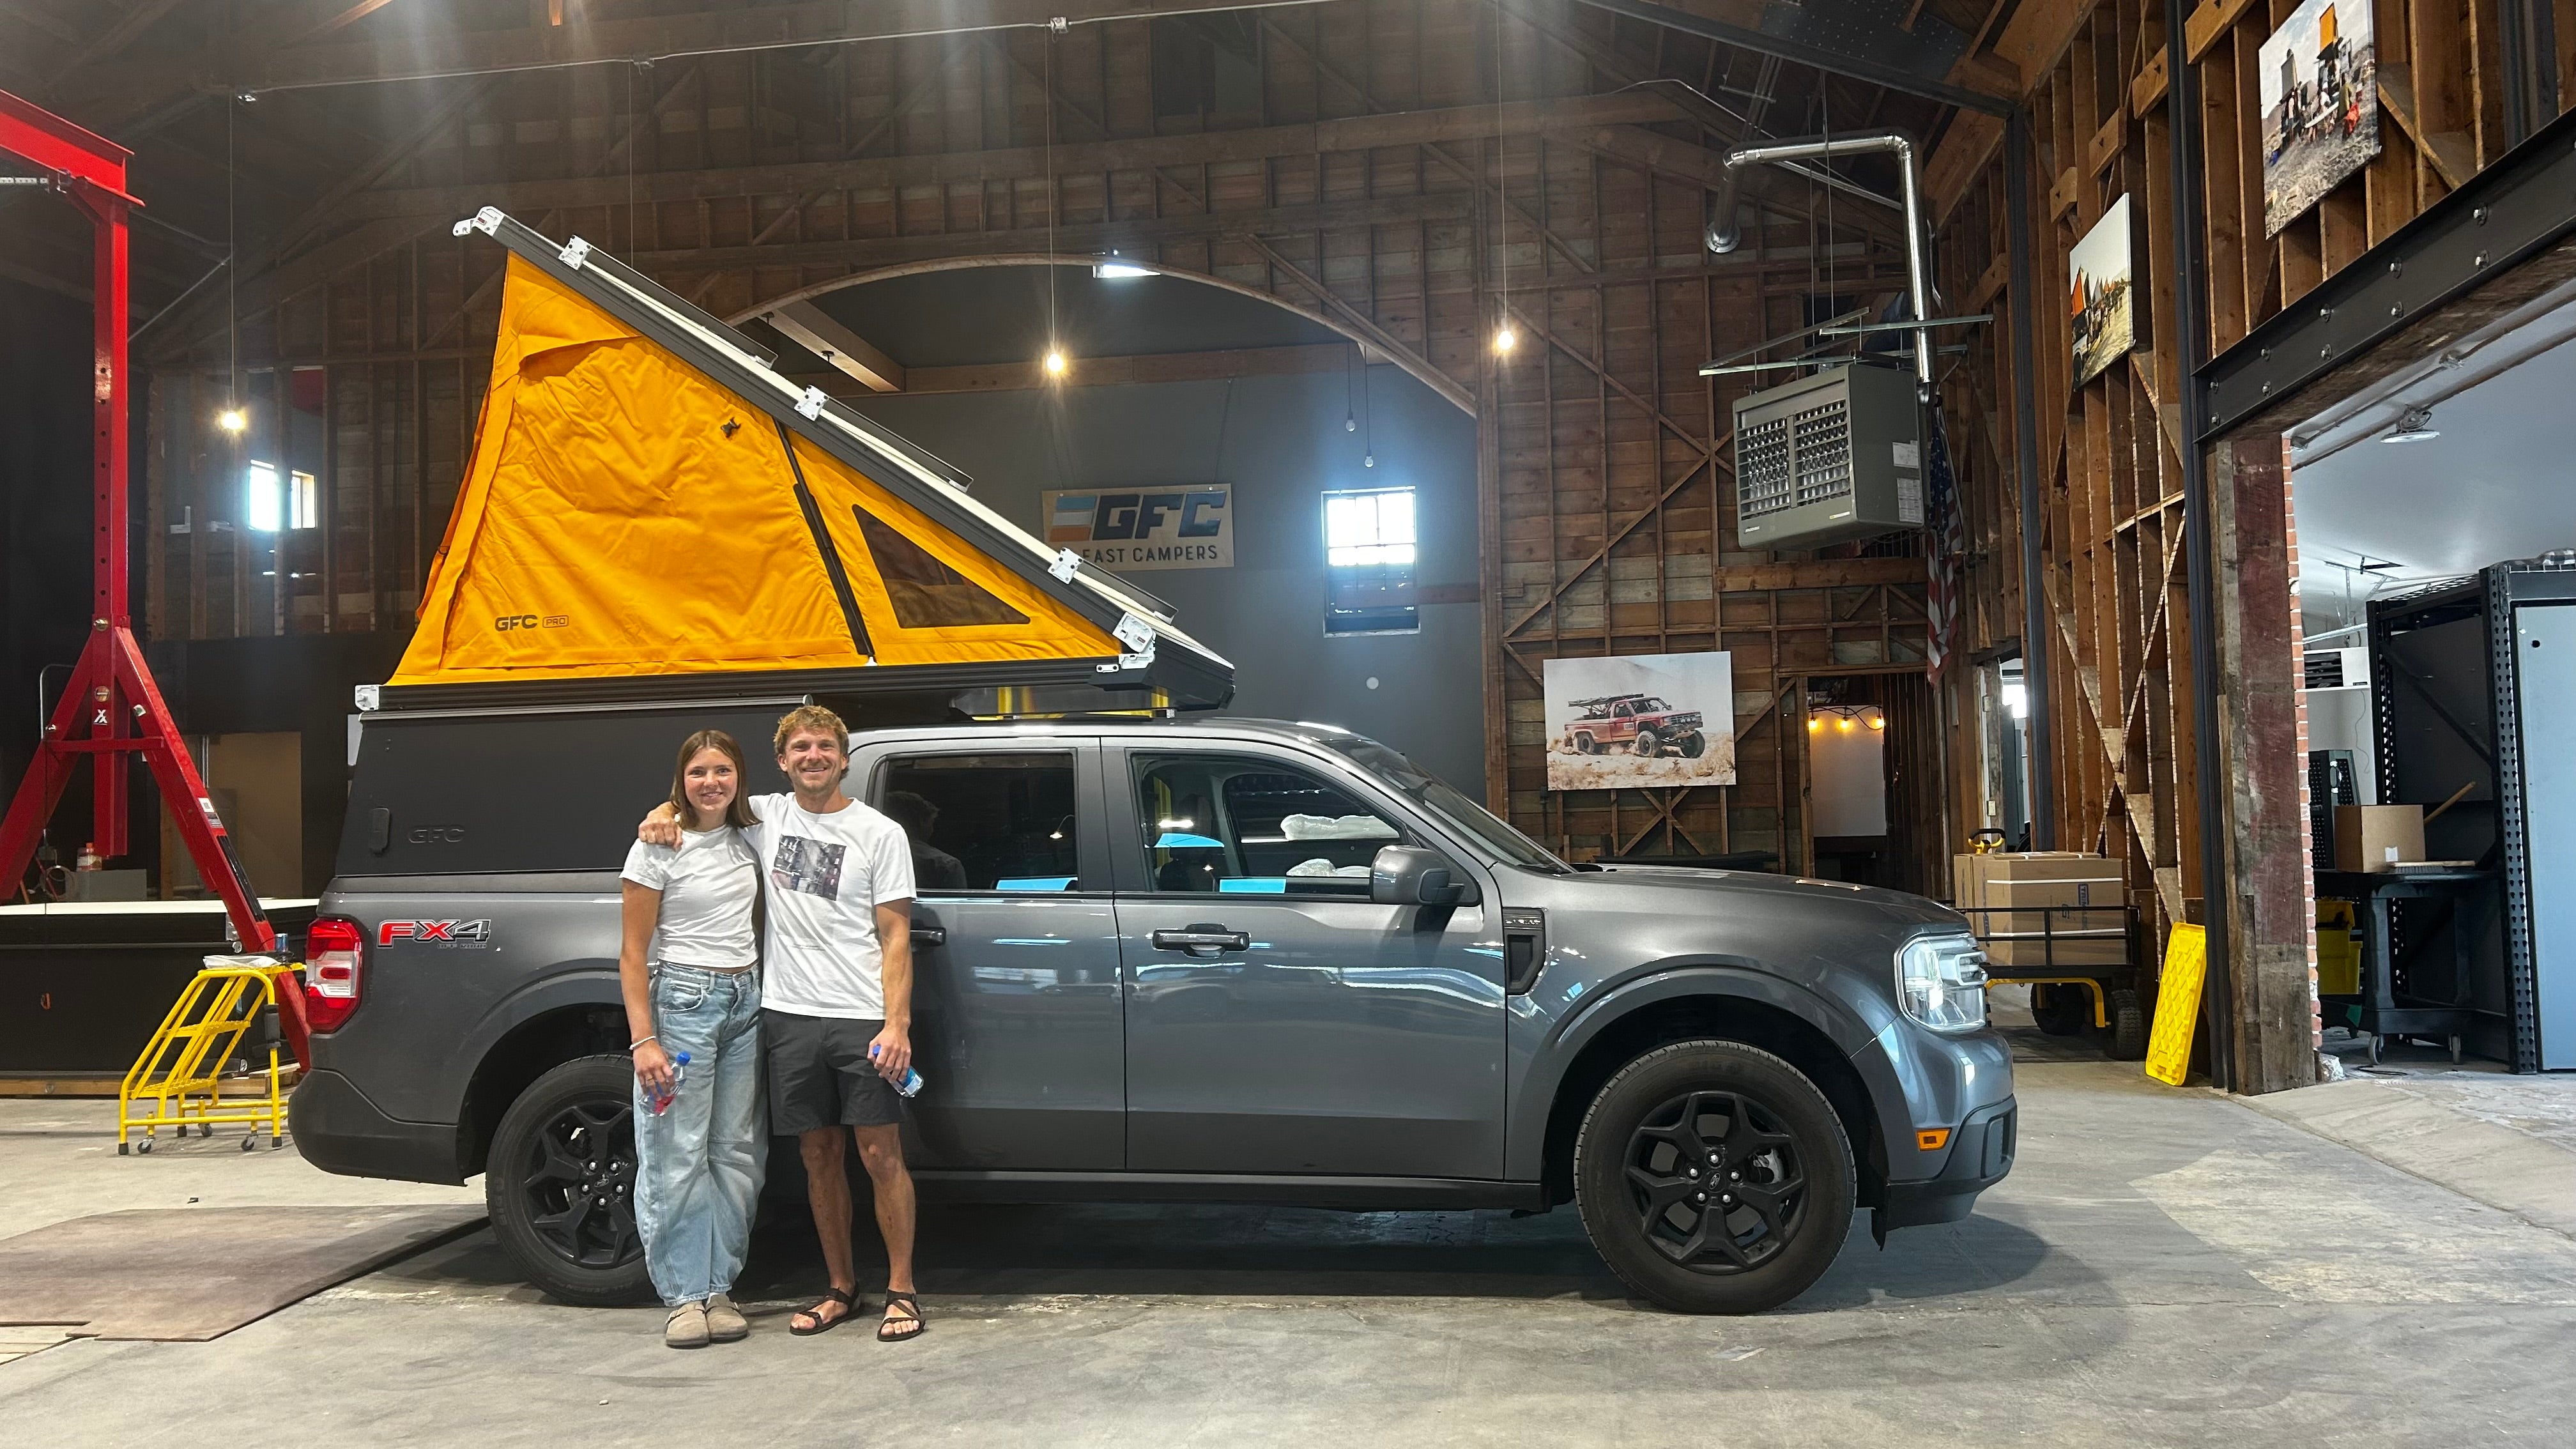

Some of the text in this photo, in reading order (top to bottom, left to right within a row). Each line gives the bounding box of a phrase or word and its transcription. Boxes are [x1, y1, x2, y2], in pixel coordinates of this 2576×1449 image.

[1092, 491, 1227, 540] GFC
[1133, 545, 1218, 563] CAMPERS
[494, 615, 567, 631] GFC PRO
[408, 827, 464, 843] GFC
[377, 919, 491, 948] FX4
